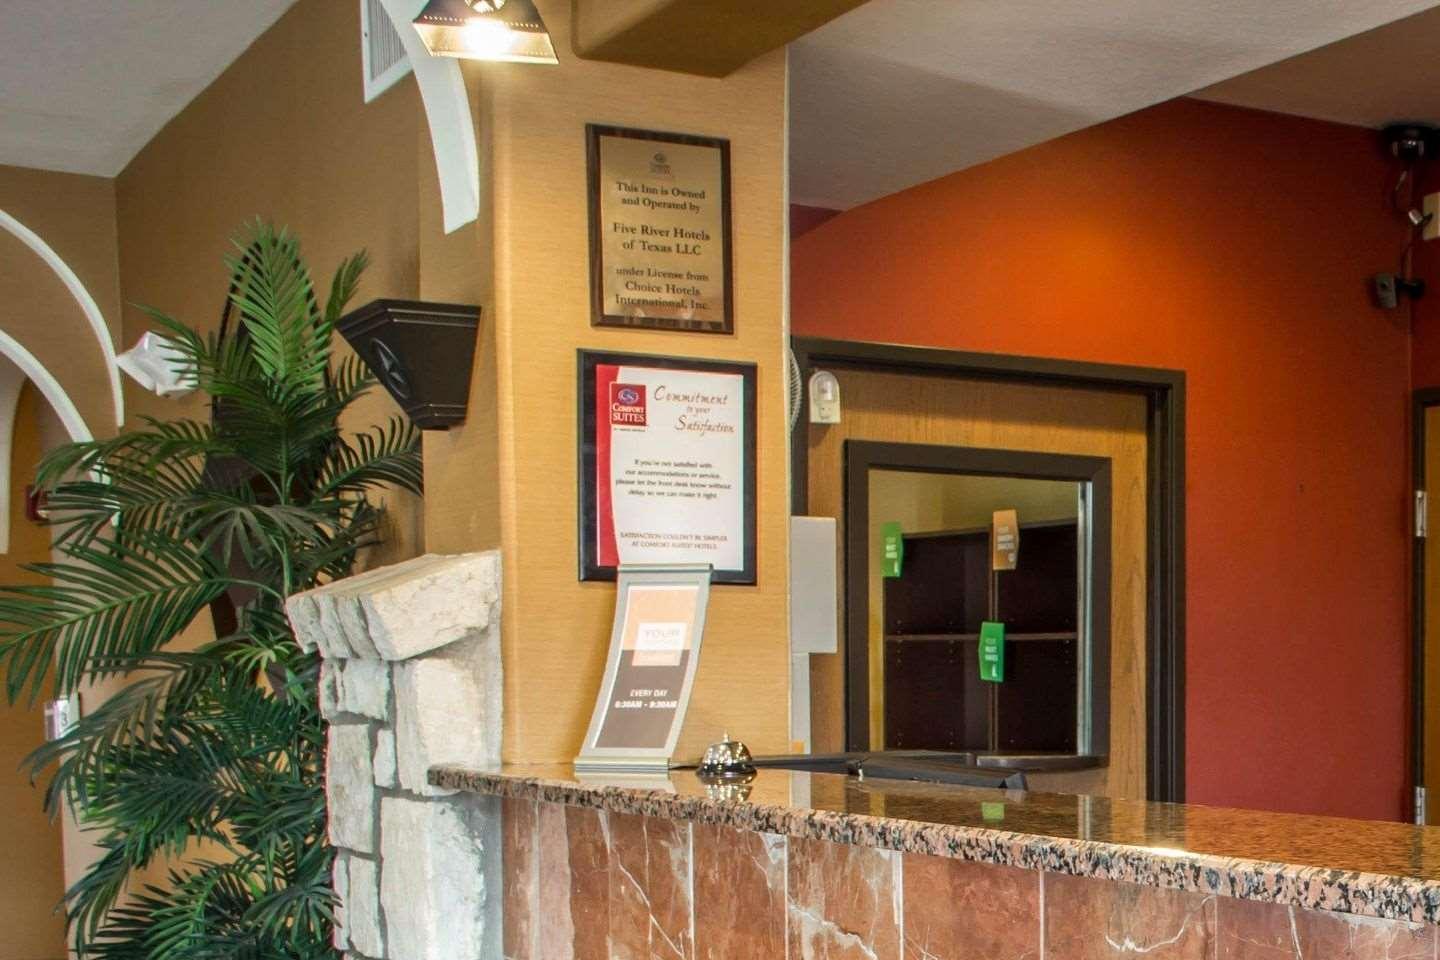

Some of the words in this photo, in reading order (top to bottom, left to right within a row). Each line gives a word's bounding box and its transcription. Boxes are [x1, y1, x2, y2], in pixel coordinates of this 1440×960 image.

[616, 182, 638, 193] This
[641, 184, 658, 195] Inn
[661, 186, 668, 195] is
[672, 187, 705, 199] Owned
[622, 197, 639, 206] and
[642, 198, 687, 210] Operated
[689, 202, 701, 214] by
[613, 222, 637, 234] Five
[641, 225, 670, 237] River
[673, 227, 710, 241] Hotels
[622, 240, 634, 250] of
[639, 240, 672, 253] Texas
[676, 243, 702, 256] LLC
[616, 267, 644, 277] under
[647, 268, 684, 279] License
[686, 271, 709, 281] from
[625, 281, 662, 293] Choice
[665, 283, 701, 296] Hotels
[615, 294, 688, 309] International,
[654, 385, 728, 405] Commitment
[612, 412, 645, 422] SUITES
[674, 415, 735, 437] Satisfaction
[653, 689, 668, 697] DAY
